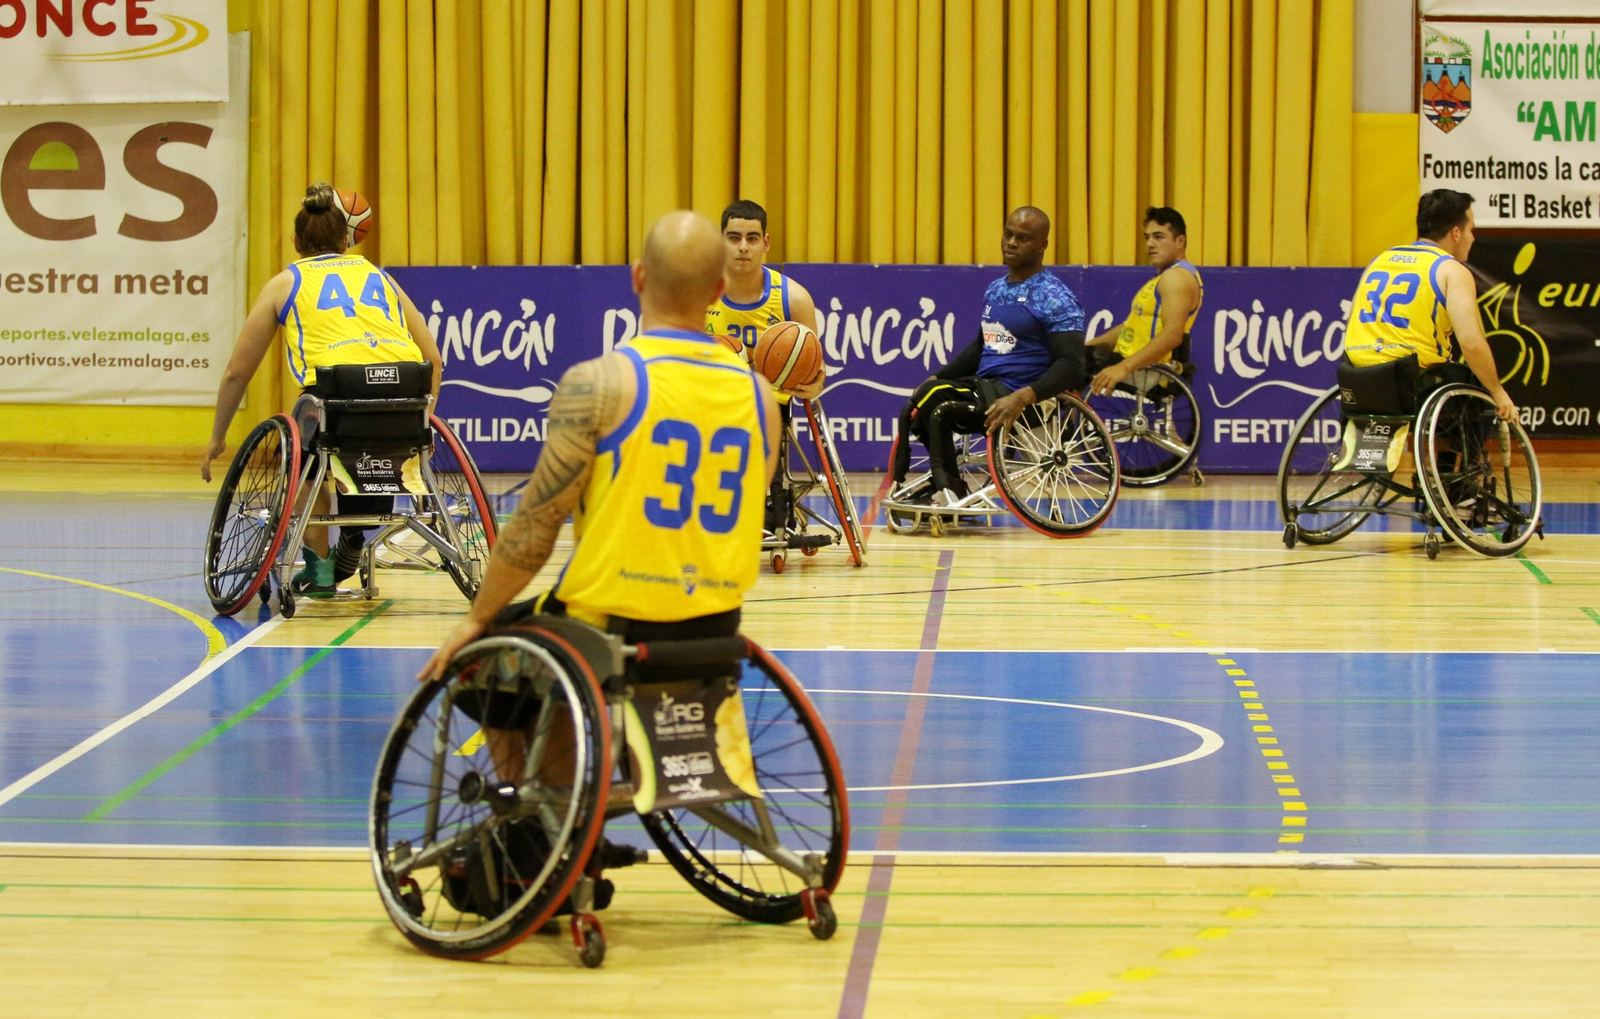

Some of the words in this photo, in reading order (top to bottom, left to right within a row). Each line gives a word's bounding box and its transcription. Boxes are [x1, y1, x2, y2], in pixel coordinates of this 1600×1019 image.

[0, 0, 158, 38] ONCE
[1481, 30, 1579, 80] Asociación
[1423, 154, 1548, 180] Fomentamos
[1555, 156, 1572, 181] la
[1524, 194, 1592, 219] Basket
[0, 268, 98, 294] estra
[114, 269, 208, 295] meta
[317, 273, 393, 322] 44
[1359, 271, 1421, 329] 32
[0, 327, 210, 345] eportes.velezmalaga.es
[369, 369, 396, 378] LINCE
[1552, 406, 1590, 426] con
[363, 483, 382, 492] 365
[644, 419, 751, 534] 33
